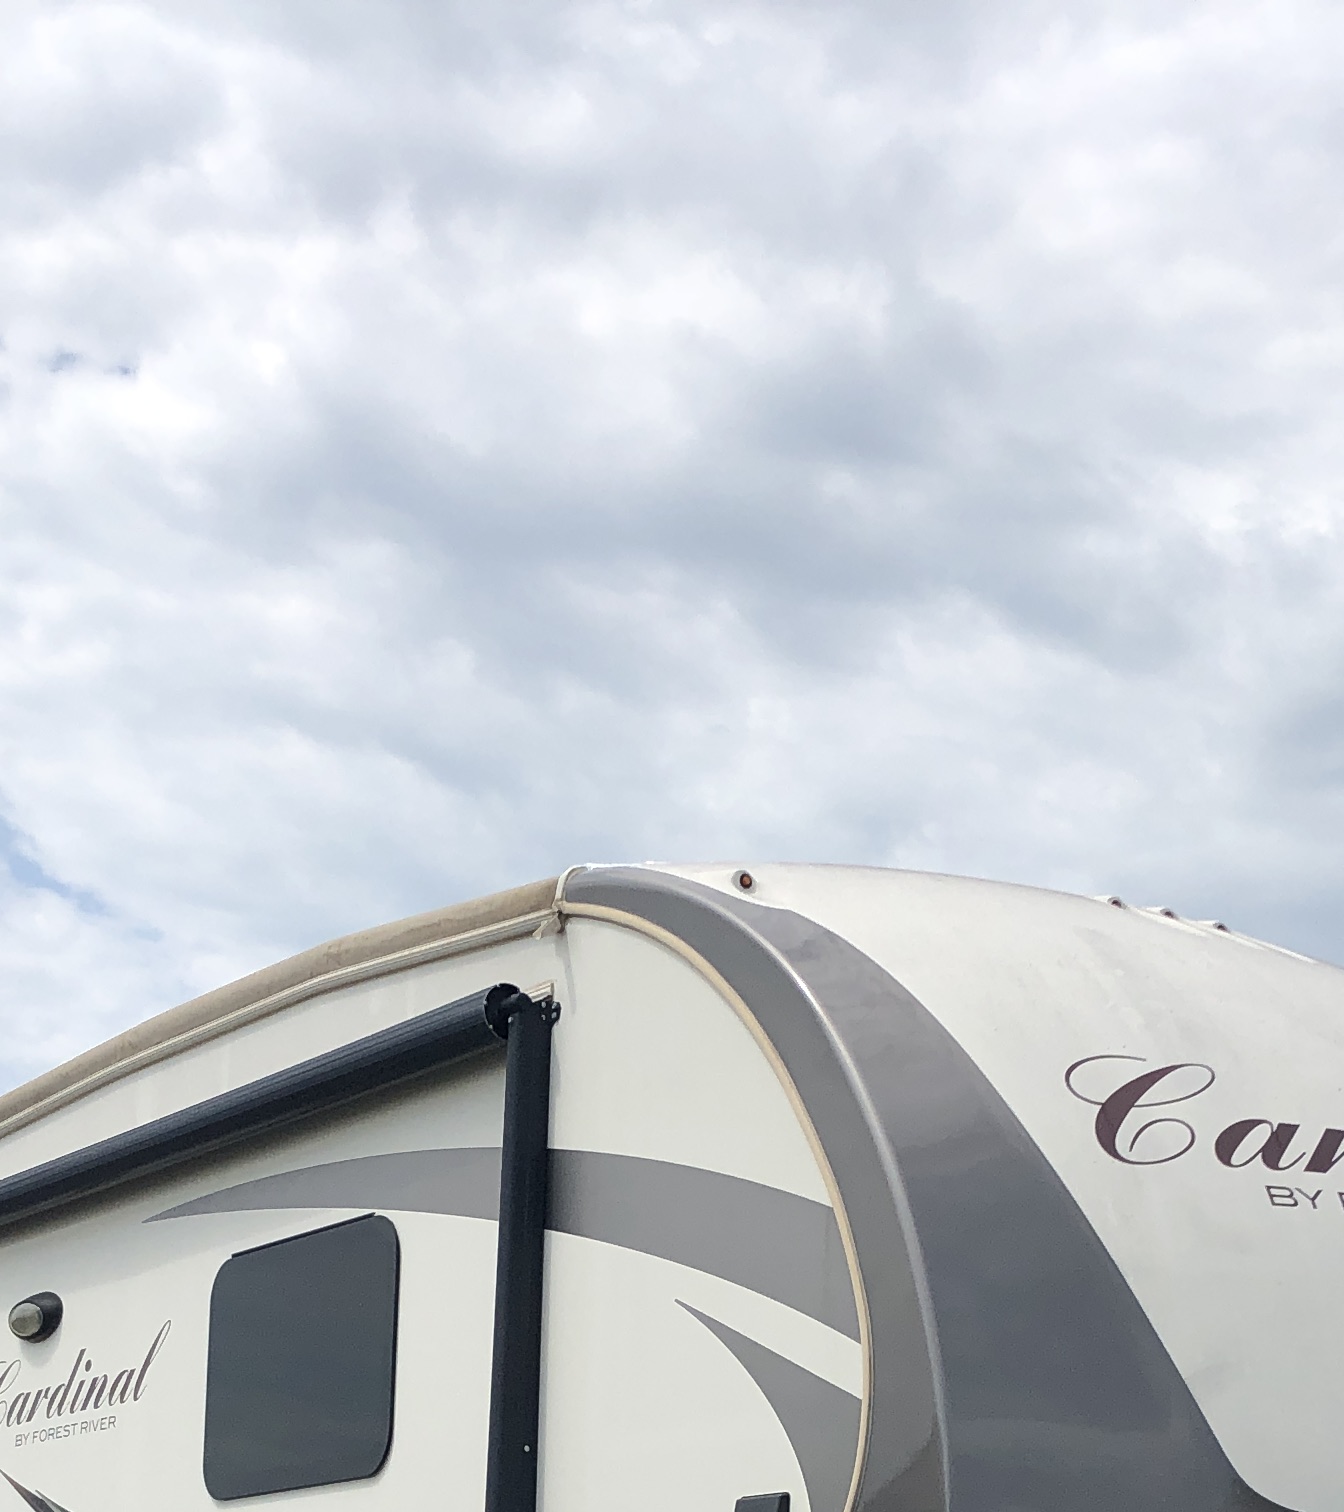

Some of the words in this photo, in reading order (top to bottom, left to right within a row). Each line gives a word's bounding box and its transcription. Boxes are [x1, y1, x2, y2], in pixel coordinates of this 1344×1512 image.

[1265, 1185, 1323, 1210] BY
[14, 1432, 30, 1447] BY
[32, 1422, 78, 1443] FOREST
[79, 1415, 117, 1434] RIVER
